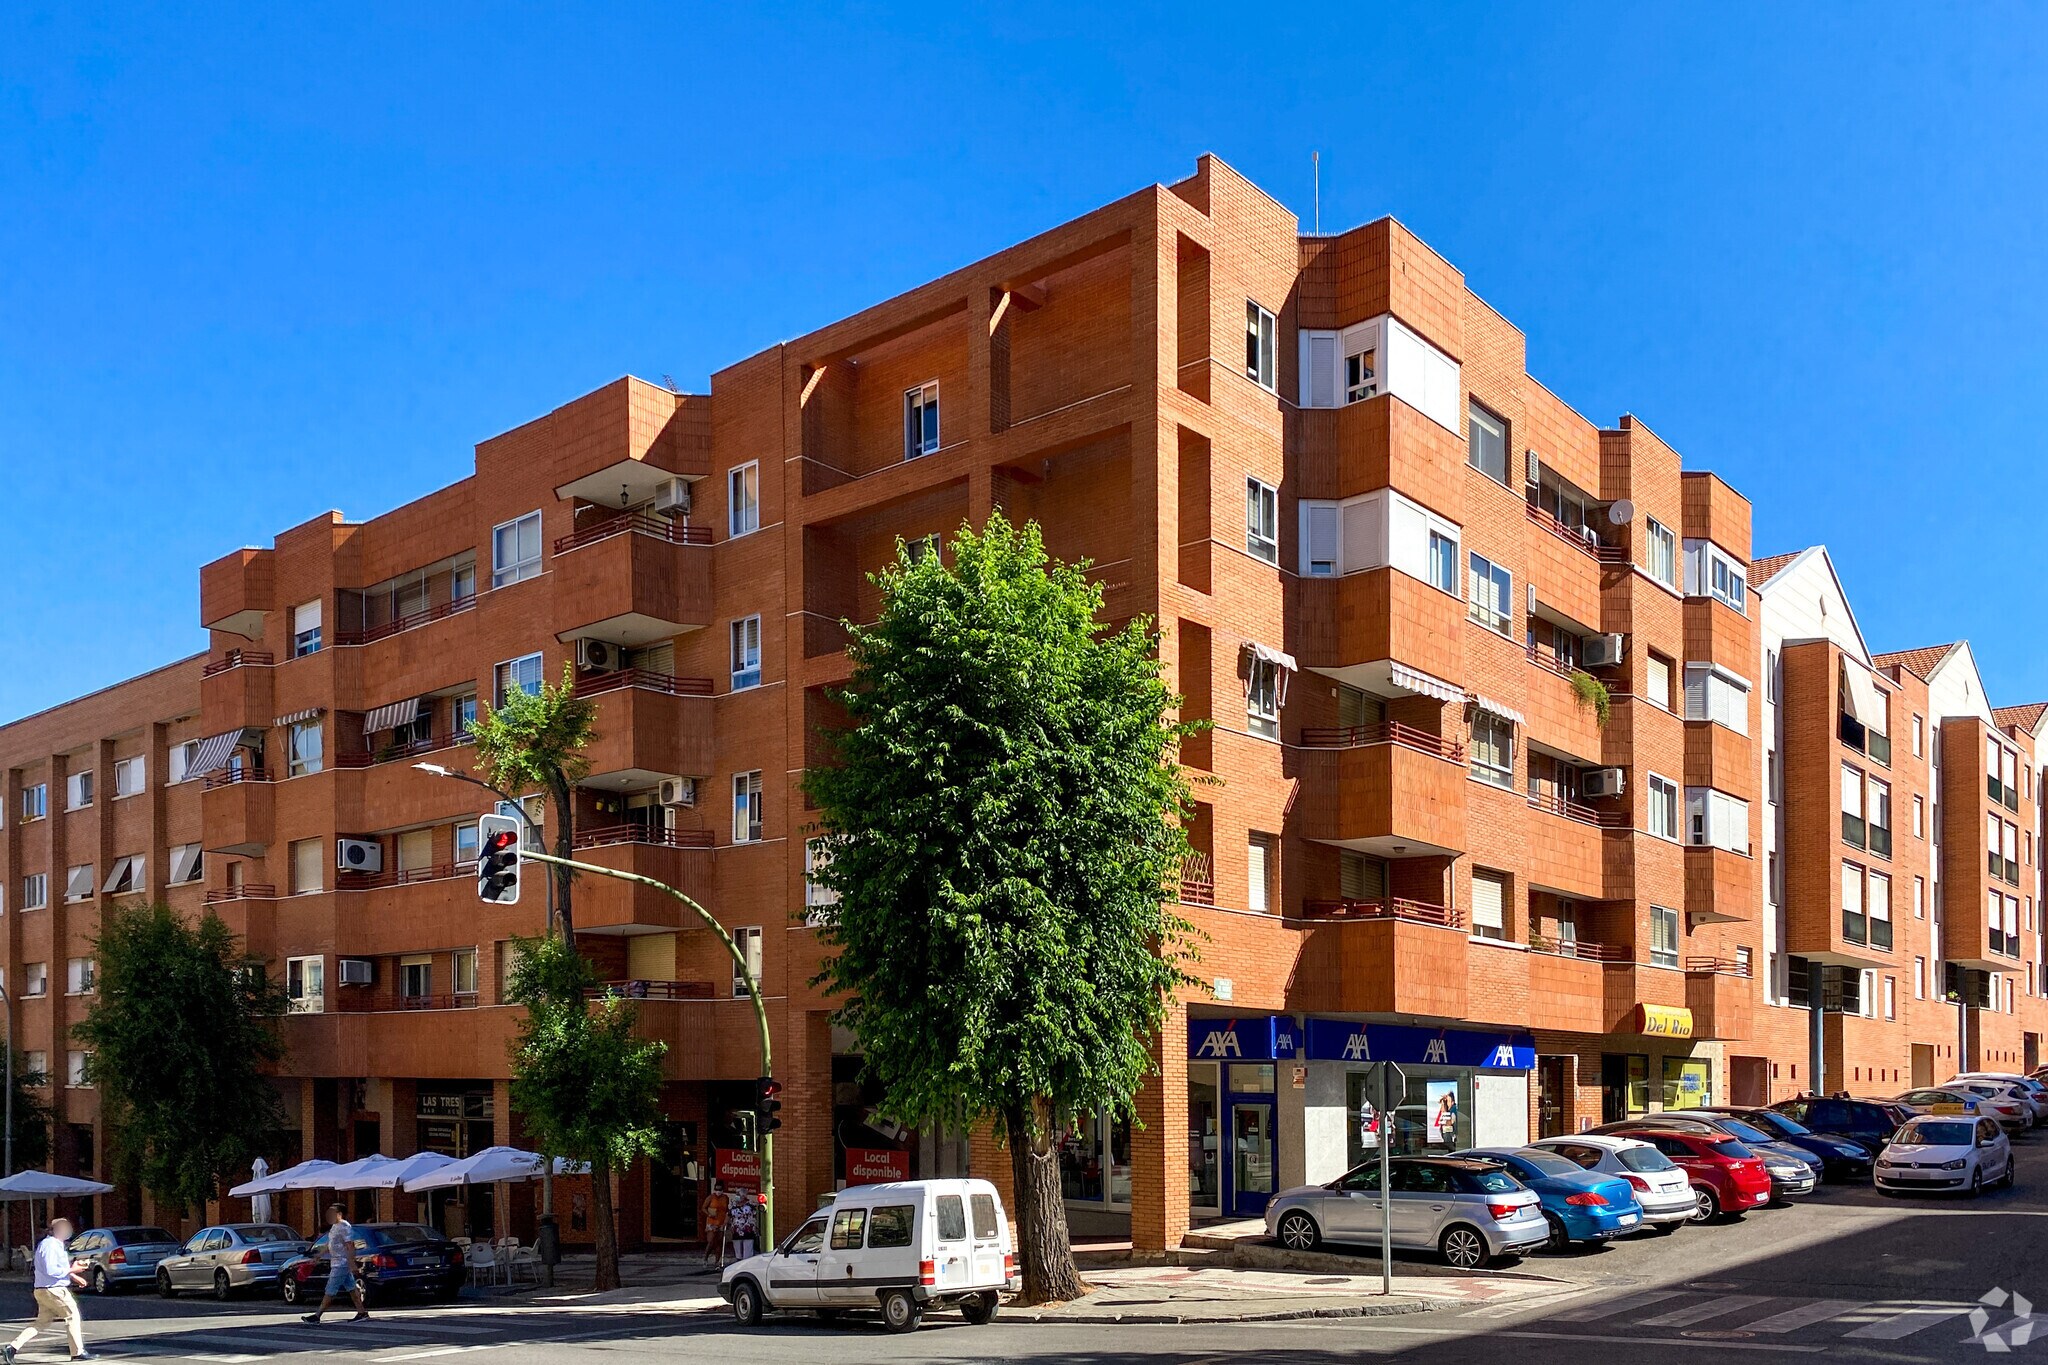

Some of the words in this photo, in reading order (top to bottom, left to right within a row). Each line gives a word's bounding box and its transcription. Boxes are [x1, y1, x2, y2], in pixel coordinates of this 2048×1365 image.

[1647, 1016, 1668, 1033] Del
[1196, 1031, 1242, 1056] AXA
[1275, 1033, 1293, 1050] AXA
[1342, 1033, 1370, 1060] AXA
[1423, 1038, 1448, 1063] AXA
[1493, 1044, 1515, 1067] AXA
[423, 1096, 437, 1107] LAS
[440, 1096, 460, 1107] TRES
[731, 1151, 753, 1163] Local
[864, 1151, 890, 1164] Local
[852, 1164, 902, 1179] disponible
